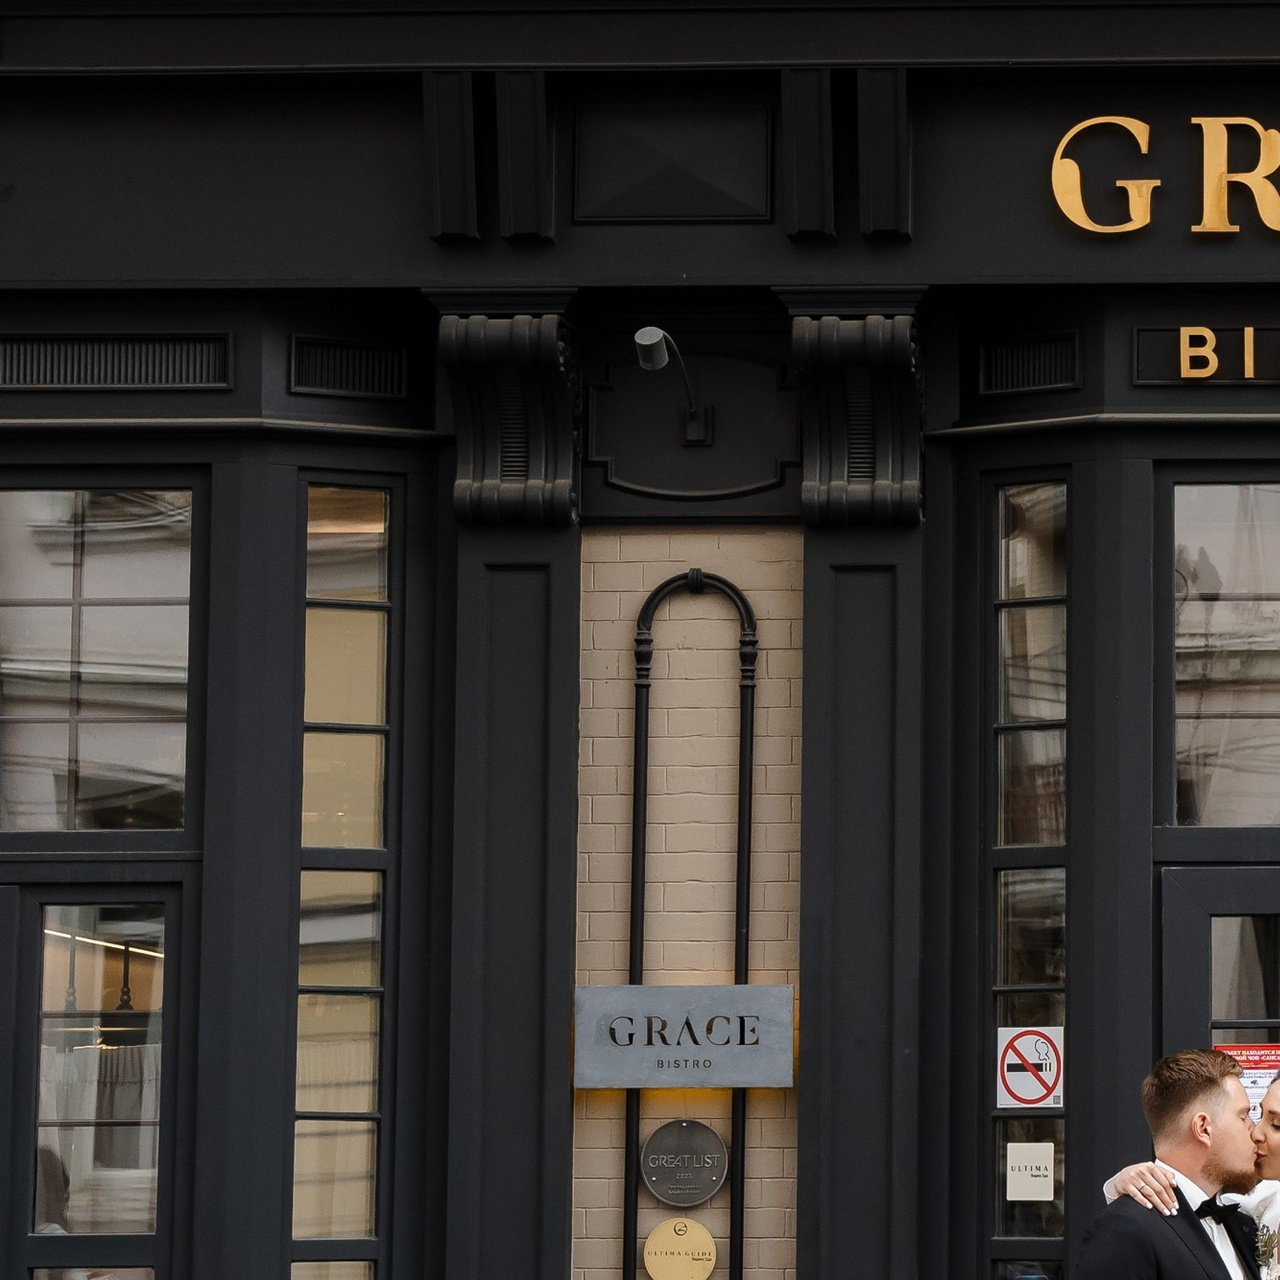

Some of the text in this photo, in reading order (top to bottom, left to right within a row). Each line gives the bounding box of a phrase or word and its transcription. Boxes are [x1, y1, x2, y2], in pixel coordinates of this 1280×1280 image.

[608, 1015, 760, 1047] GRACE
[656, 1059, 712, 1069] BISTRO
[648, 1154, 720, 1168] GREAT LIST
